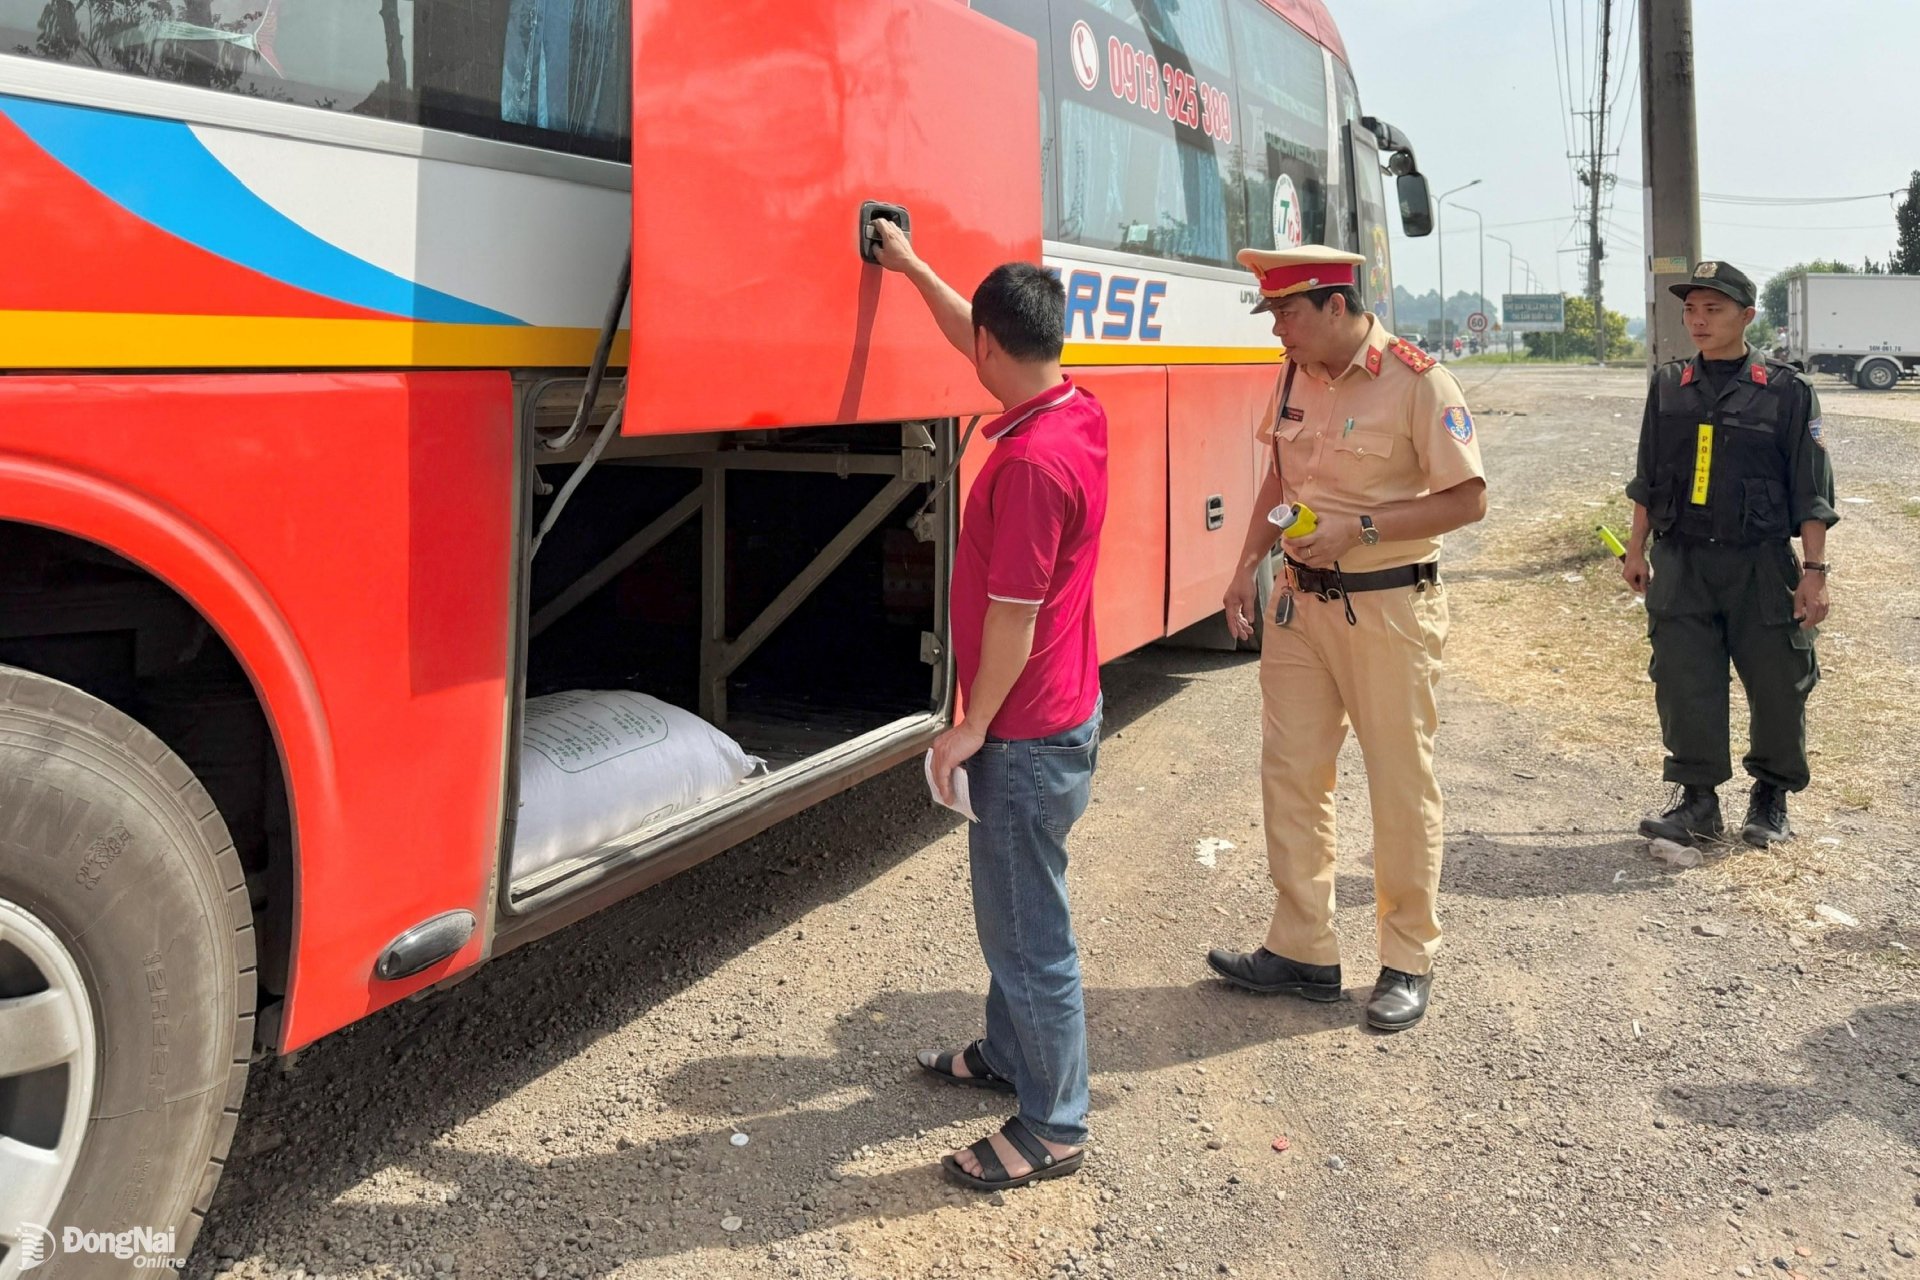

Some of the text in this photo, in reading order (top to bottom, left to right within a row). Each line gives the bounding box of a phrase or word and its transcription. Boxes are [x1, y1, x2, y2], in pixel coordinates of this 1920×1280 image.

[1108, 35, 1232, 144] 0913 325 389
[1043, 265, 1168, 342] RSE
[1471, 318, 1484, 328] 60
[1697, 435, 1708, 494] POLICE
